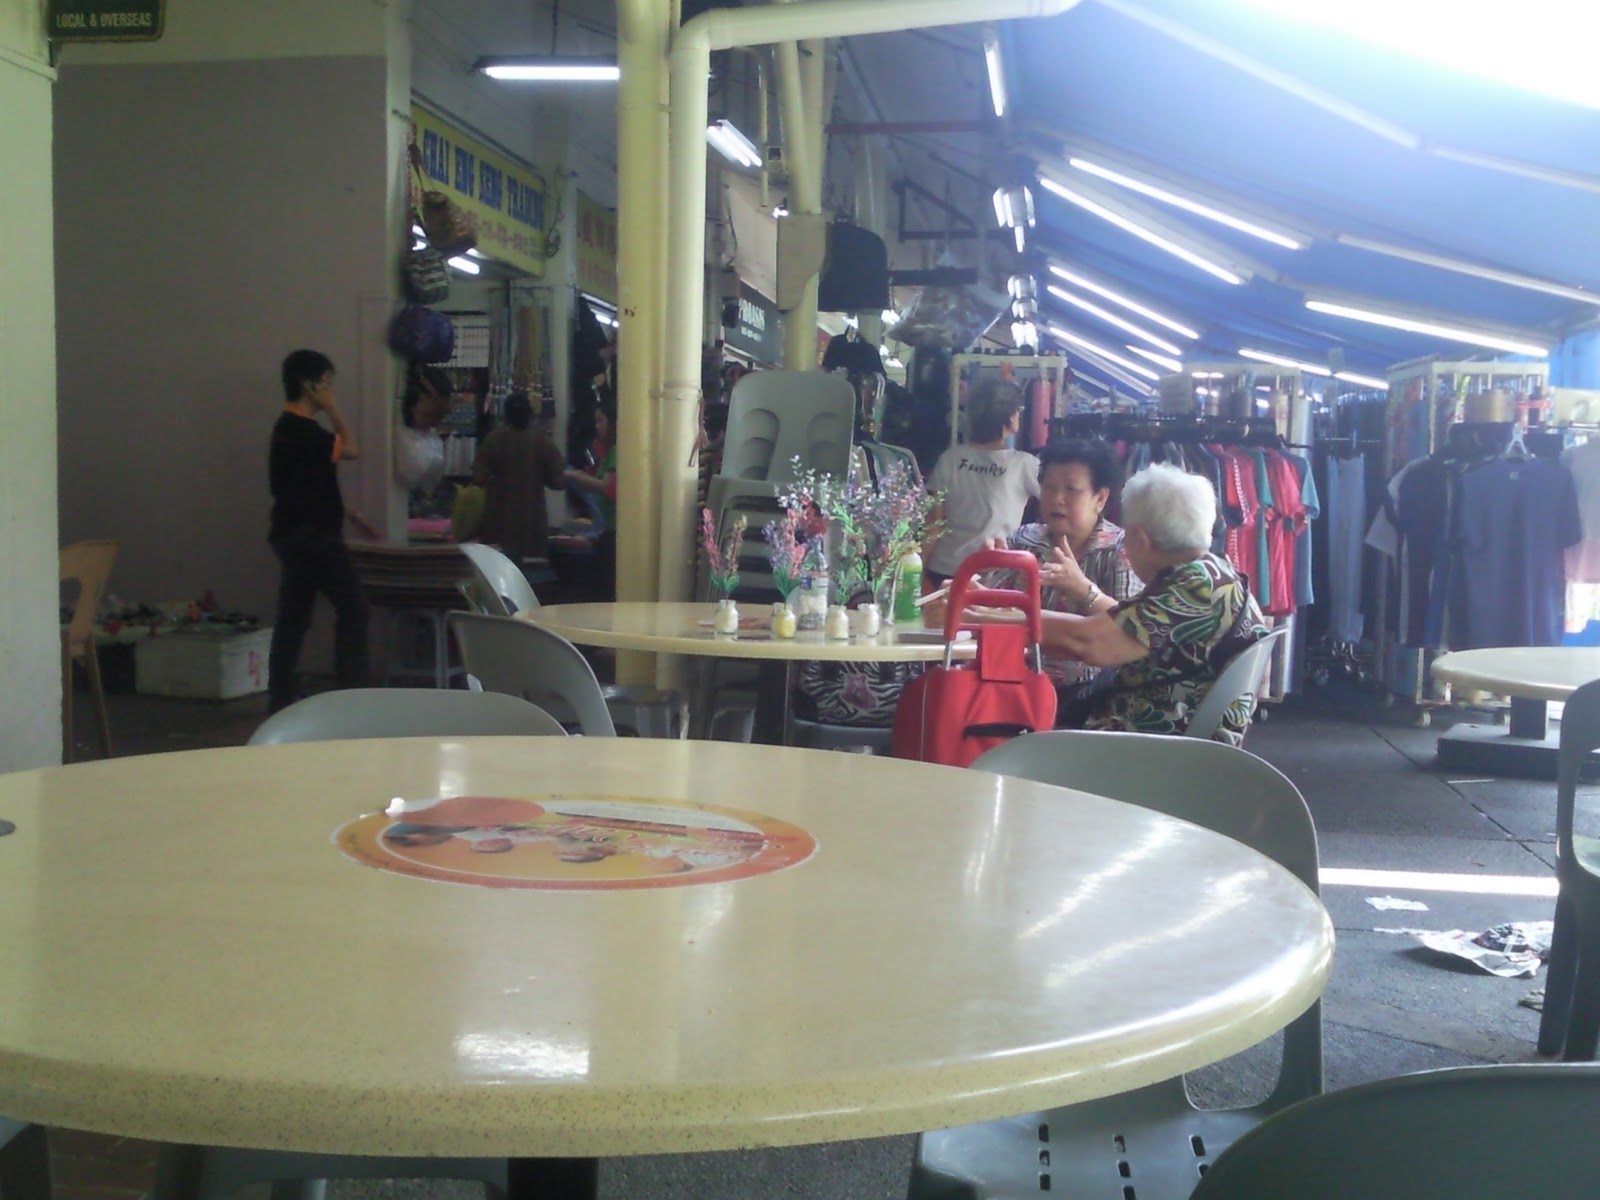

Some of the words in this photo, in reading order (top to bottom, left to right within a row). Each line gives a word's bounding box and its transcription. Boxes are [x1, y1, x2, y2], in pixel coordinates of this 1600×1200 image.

[56, 13, 86, 27] LOCAL
[89, 13, 98, 27] &
[100, 13, 153, 27] OVERSEAS
[958, 458, 1008, 477] Funky
